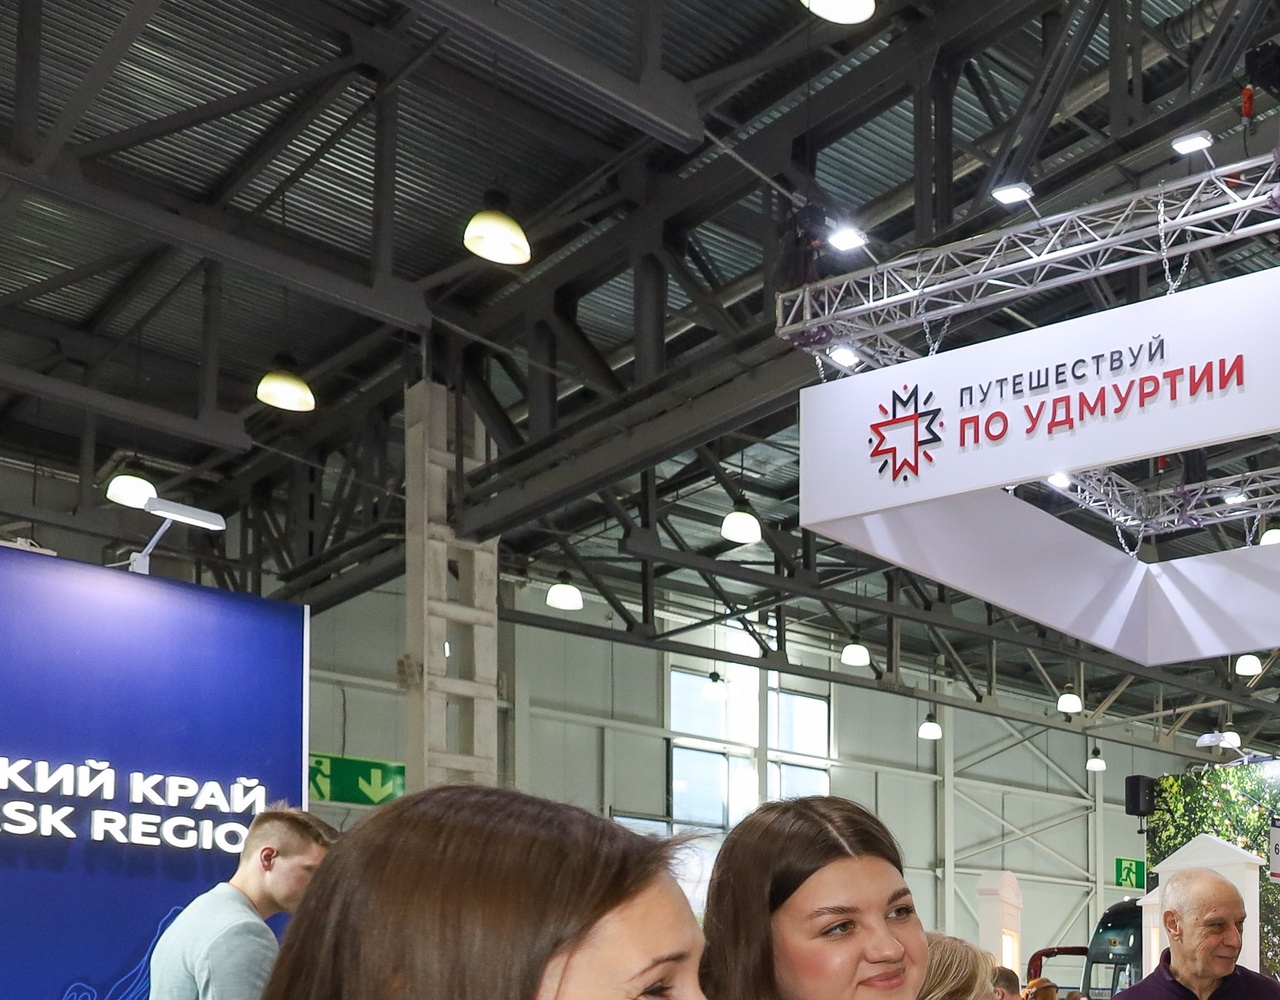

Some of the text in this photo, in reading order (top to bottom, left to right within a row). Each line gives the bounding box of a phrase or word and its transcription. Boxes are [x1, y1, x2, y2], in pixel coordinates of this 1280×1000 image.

[959, 333, 1166, 408] ПУТЕШЕСТВУЙ
[959, 353, 1244, 447] ПО УДМУРТИИ
[0, 801, 251, 854] SK REGIO
[129, 776, 267, 816] КРАЙ
